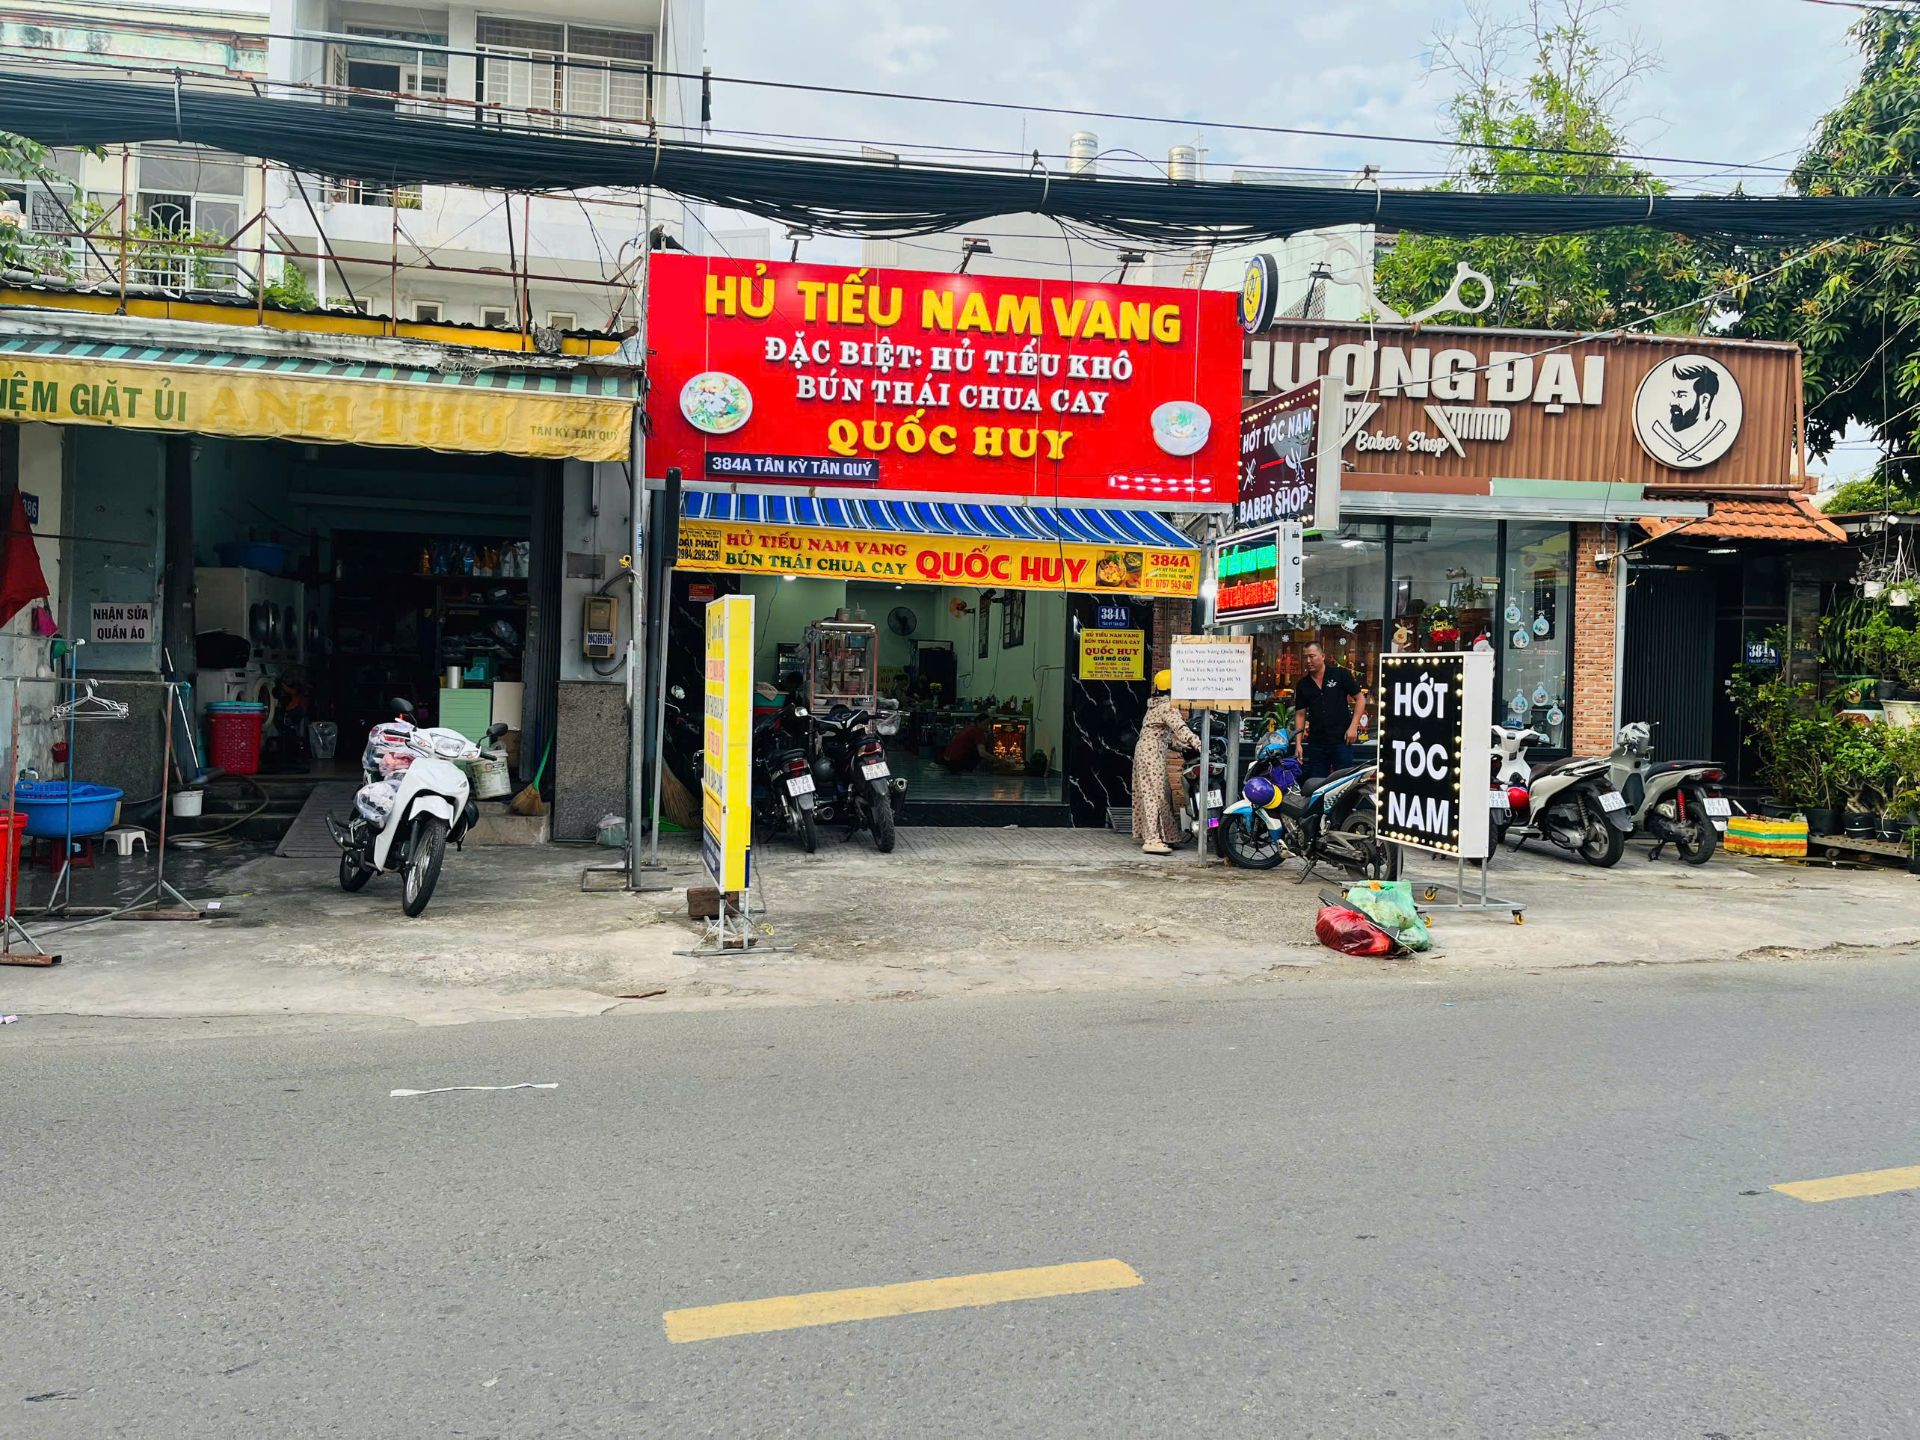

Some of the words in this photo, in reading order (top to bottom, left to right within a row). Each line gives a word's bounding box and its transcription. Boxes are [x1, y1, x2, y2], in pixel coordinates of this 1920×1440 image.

[705, 262, 775, 319] HỦ
[797, 268, 903, 327] TIẾU
[922, 289, 1043, 336] NAM
[1051, 297, 1181, 343] VANG
[765, 331, 830, 369] ĐẶC
[840, 336, 922, 374] BIỆT:
[931, 338, 975, 372] HỦ
[985, 338, 1061, 377] TIẾU
[1068, 350, 1133, 381] KHÔ
[70, 379, 143, 425] GIẶT
[154, 377, 187, 422] ỦI
[796, 368, 863, 401] BÚN
[871, 372, 950, 406] THÁI
[959, 385, 1042, 411] CHUA
[1051, 389, 1109, 414] CAY
[1484, 350, 1605, 413] ĐẠI
[530, 424, 552, 437] TÂN
[828, 408, 957, 456] QUỐC
[973, 426, 1073, 460] HUY
[1242, 423, 1261, 454] HỚT
[1263, 415, 1285, 446] TÓC
[1288, 409, 1312, 438] NAM
[1355, 429, 1402, 452] Baber
[1406, 430, 1449, 458] Shop
[712, 456, 752, 472] 384A
[754, 457, 784, 473] TÂN
[788, 458, 808, 474] KỲ
[811, 460, 840, 475] TÂN
[843, 462, 872, 477] QUÝ
[1240, 494, 1272, 523] BABER
[1275, 484, 1308, 515] SHOP
[726, 529, 753, 546] HỦ
[759, 531, 803, 549] TIẾU
[808, 538, 849, 553] NAM
[855, 541, 908, 556] VANG
[1150, 553, 1190, 568] 384A
[725, 550, 764, 565] BÚN
[768, 554, 811, 569] THÁI
[817, 558, 866, 573] CHUA
[871, 561, 907, 575] CAY
[915, 544, 1011, 580] QUỐC
[1020, 555, 1088, 583] HUY
[93, 606, 124, 622] NHẬN
[127, 605, 148, 620] SỬA
[130, 625, 145, 639] ÁO
[1101, 608, 1126, 620] 384A
[1085, 645, 1114, 655] QUỐC
[1394, 671, 1448, 718] HỚT
[1392, 731, 1449, 781] TÓC
[1388, 791, 1450, 836] NAM
